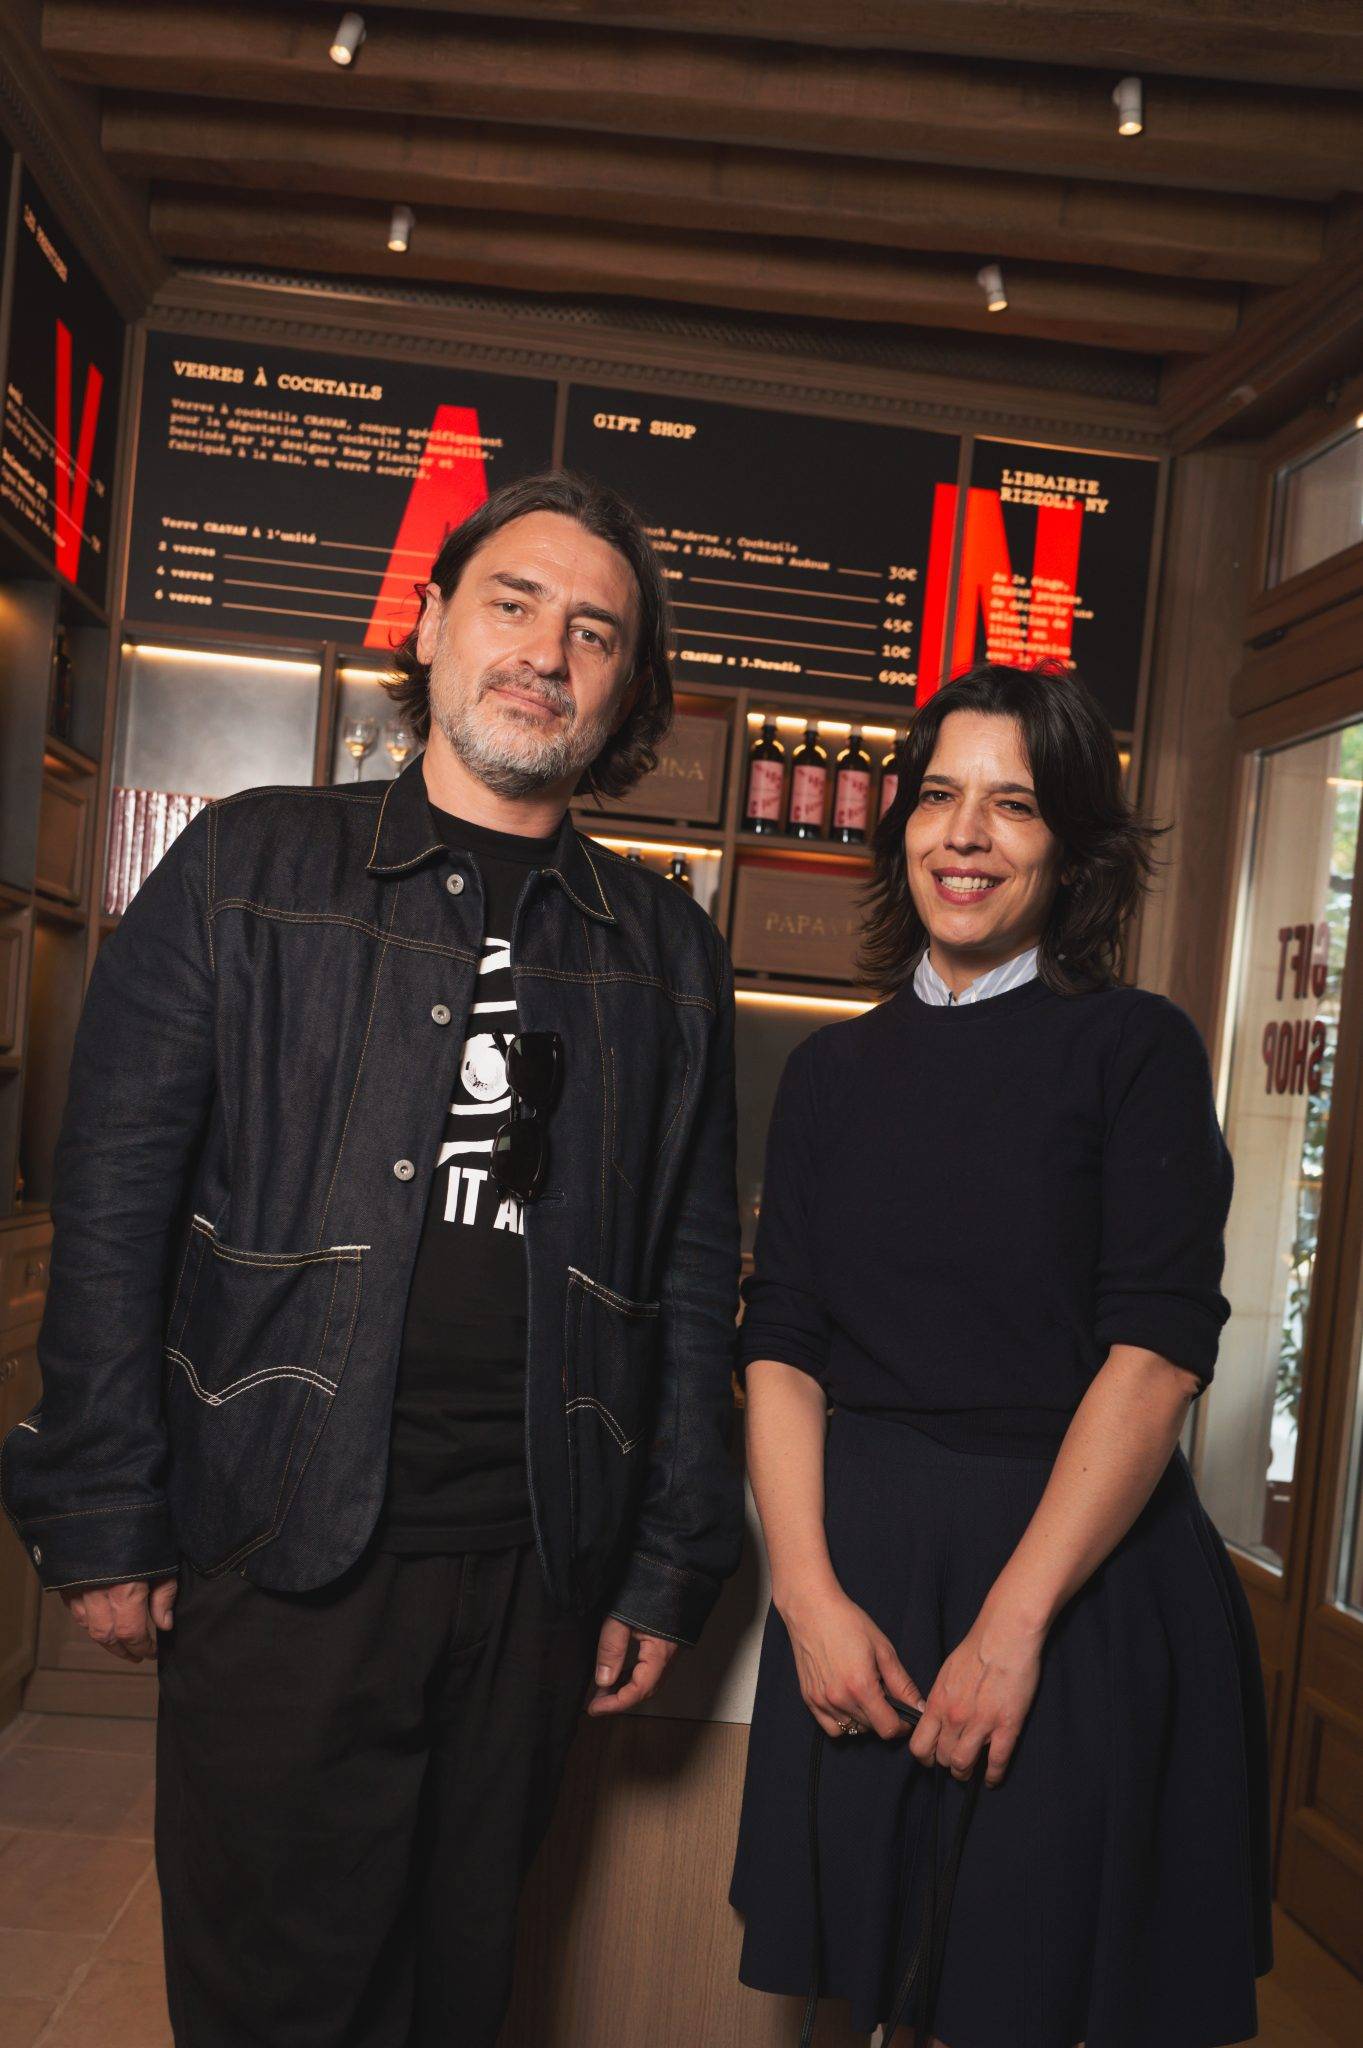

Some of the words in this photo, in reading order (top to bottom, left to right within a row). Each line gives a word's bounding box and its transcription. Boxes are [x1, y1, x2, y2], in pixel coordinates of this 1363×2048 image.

[172, 360, 244, 384] VERRES
[253, 366, 268, 387] À
[277, 374, 383, 400] COCKTAILS
[234, 407, 298, 424] cocktails
[593, 413, 641, 433] GIFT
[650, 420, 697, 439] SHOP
[1001, 469, 1100, 496] LIBRAIRIE
[1000, 487, 1076, 511] RIZZOLI
[1085, 497, 1109, 514] NY
[161, 516, 198, 531] Verre
[203, 521, 248, 537] CRAVAN
[172, 544, 216, 557] verres
[170, 569, 214, 582] verres
[889, 566, 918, 582] 30€
[169, 592, 212, 606] verres
[885, 591, 906, 606] 4€
[882, 644, 911, 660] 10€
[879, 669, 918, 686] 690€
[444, 1165, 488, 1225] IT
[493, 1199, 525, 1235] A
